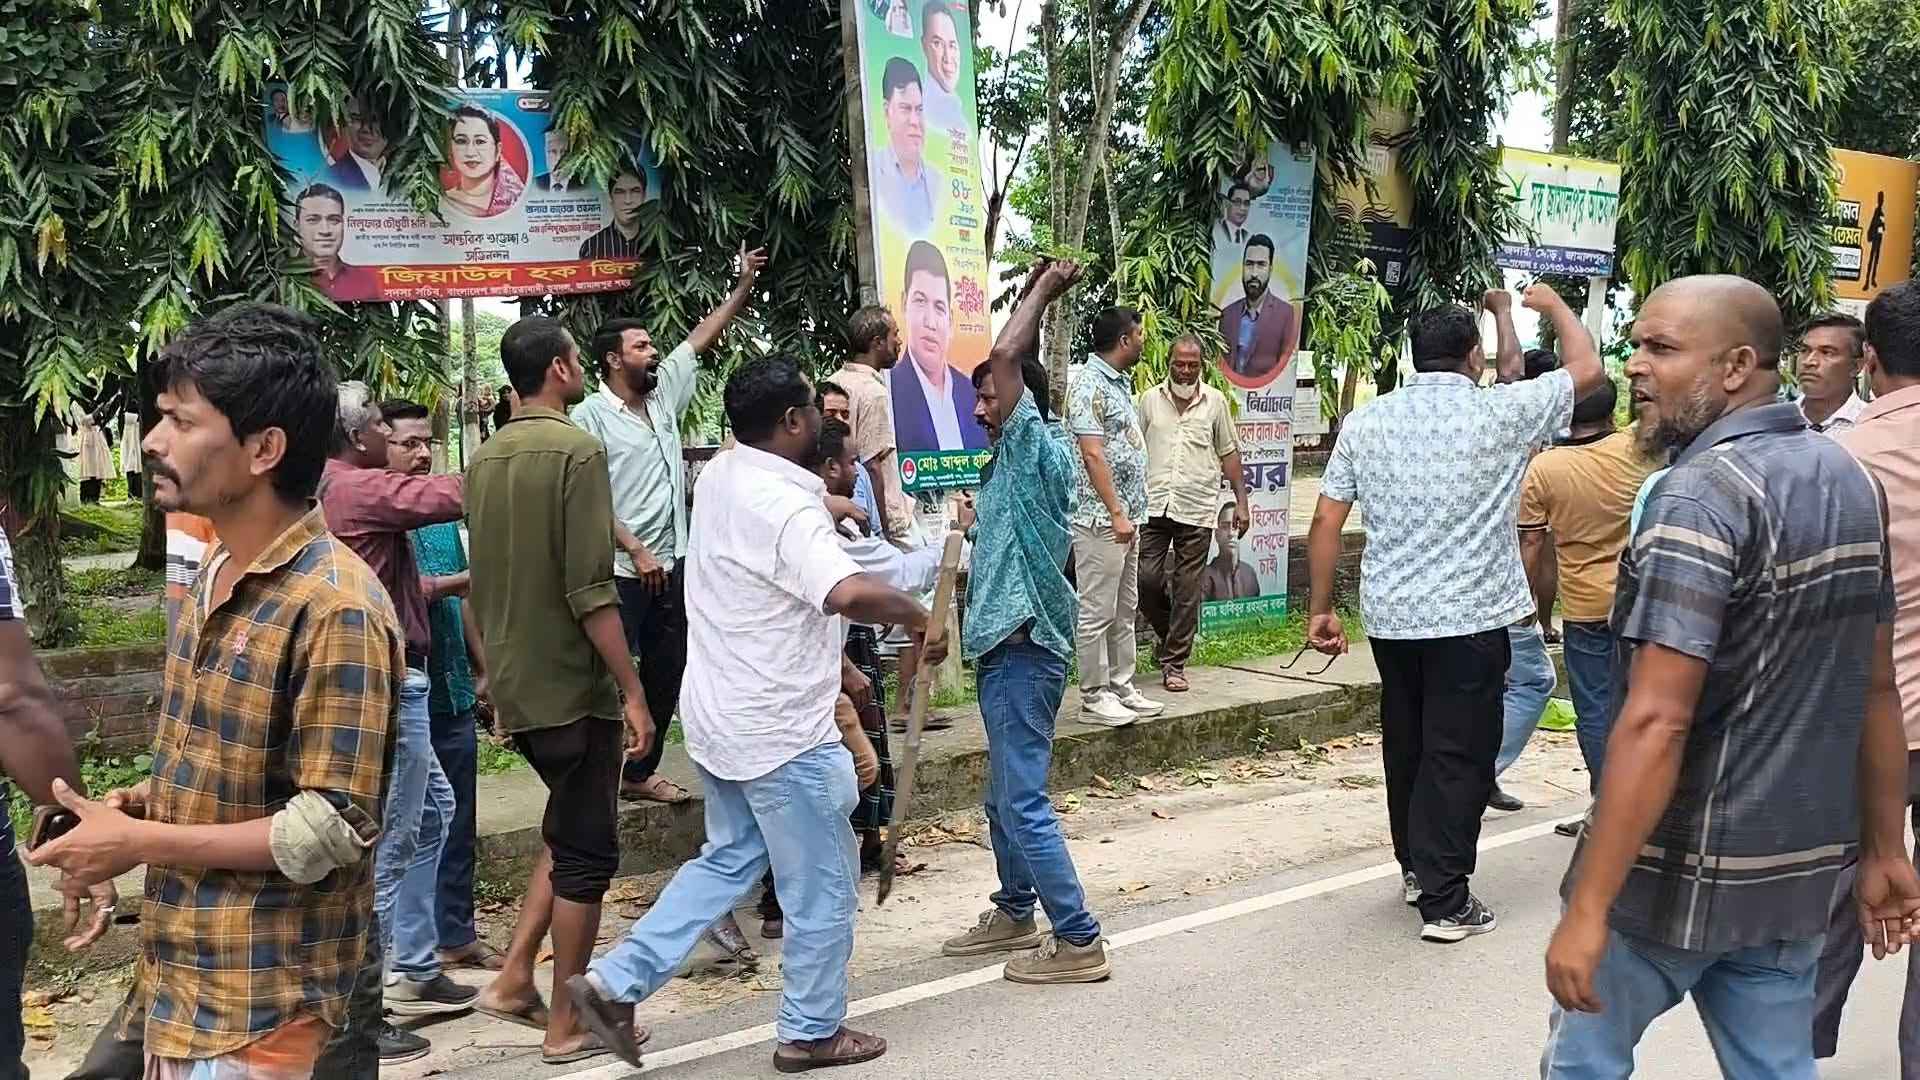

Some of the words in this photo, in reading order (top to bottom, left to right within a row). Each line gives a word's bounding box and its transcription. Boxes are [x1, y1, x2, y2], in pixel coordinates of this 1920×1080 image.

[380, 264, 514, 284] জিয়াউল
[526, 265, 579, 281] হক
[1251, 504, 1288, 528] হিসেবে
[1251, 532, 1287, 553] দেখতে
